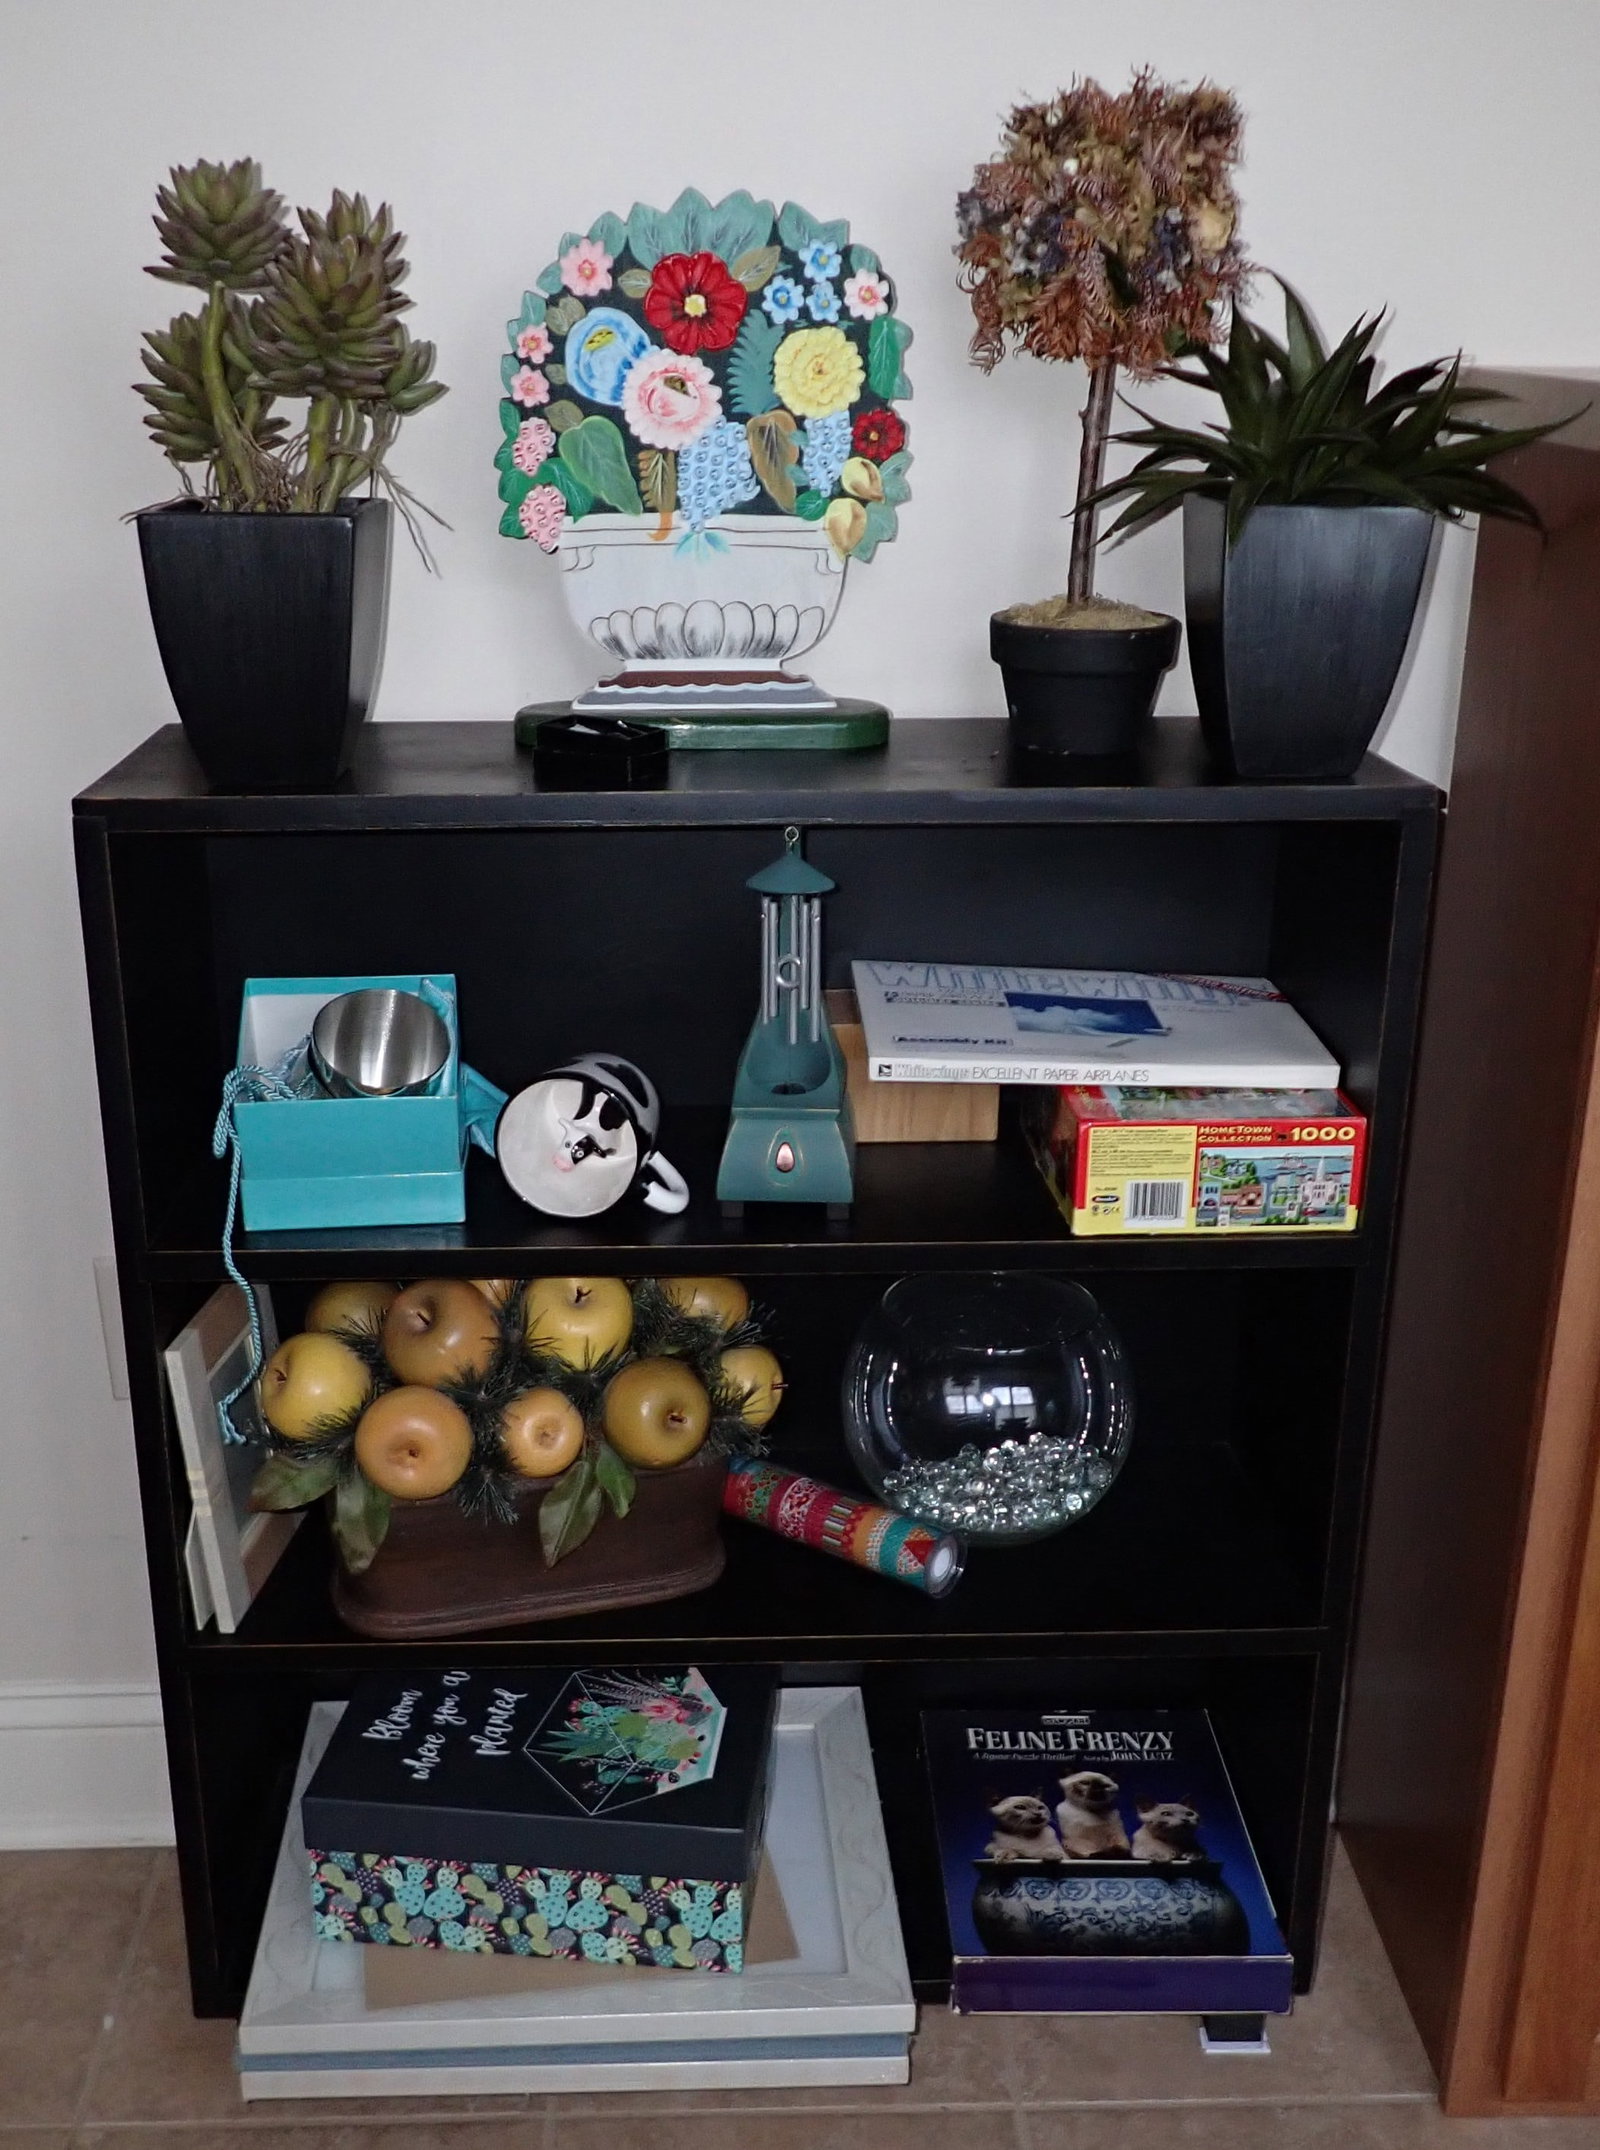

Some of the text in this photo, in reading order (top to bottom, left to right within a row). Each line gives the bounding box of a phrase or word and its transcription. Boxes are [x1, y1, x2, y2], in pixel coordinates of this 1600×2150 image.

[972, 1066, 1038, 1080] EXCELLENT
[1044, 1067, 1079, 1081] PAPER
[1083, 1069, 1149, 1083] AIRPLANES
[1291, 1126, 1356, 1142] 1000
[362, 1689, 423, 1741] Bloom
[469, 1688, 529, 1756] planted
[402, 1732, 446, 1780] where
[433, 1693, 468, 1726] you
[966, 1727, 1174, 1750] FELINE FRENZY
